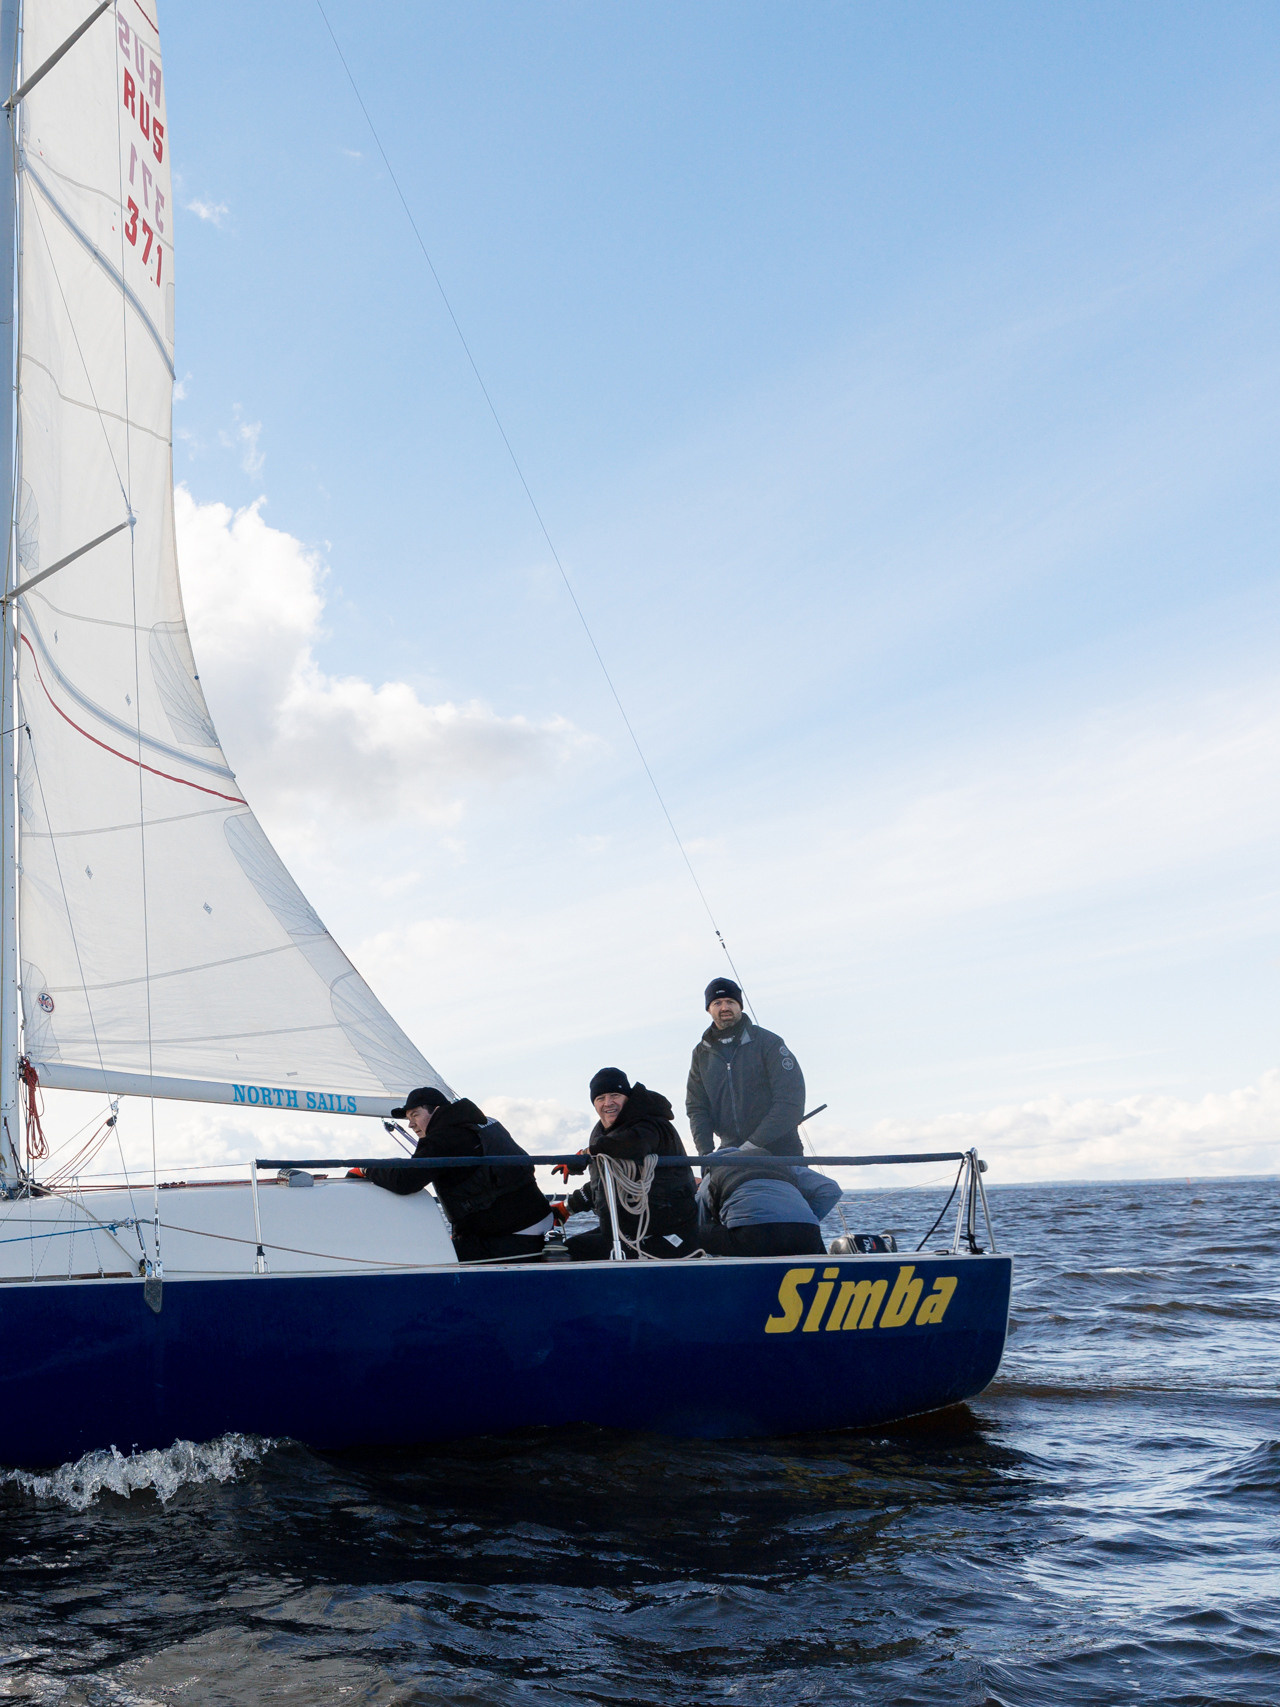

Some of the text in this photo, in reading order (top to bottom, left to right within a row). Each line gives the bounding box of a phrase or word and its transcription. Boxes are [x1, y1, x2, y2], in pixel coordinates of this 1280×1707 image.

[123, 66, 165, 165] RUS
[124, 195, 164, 288] 371
[231, 1083, 357, 1114] NORTH SAILS
[764, 1265, 959, 1334] Simba
